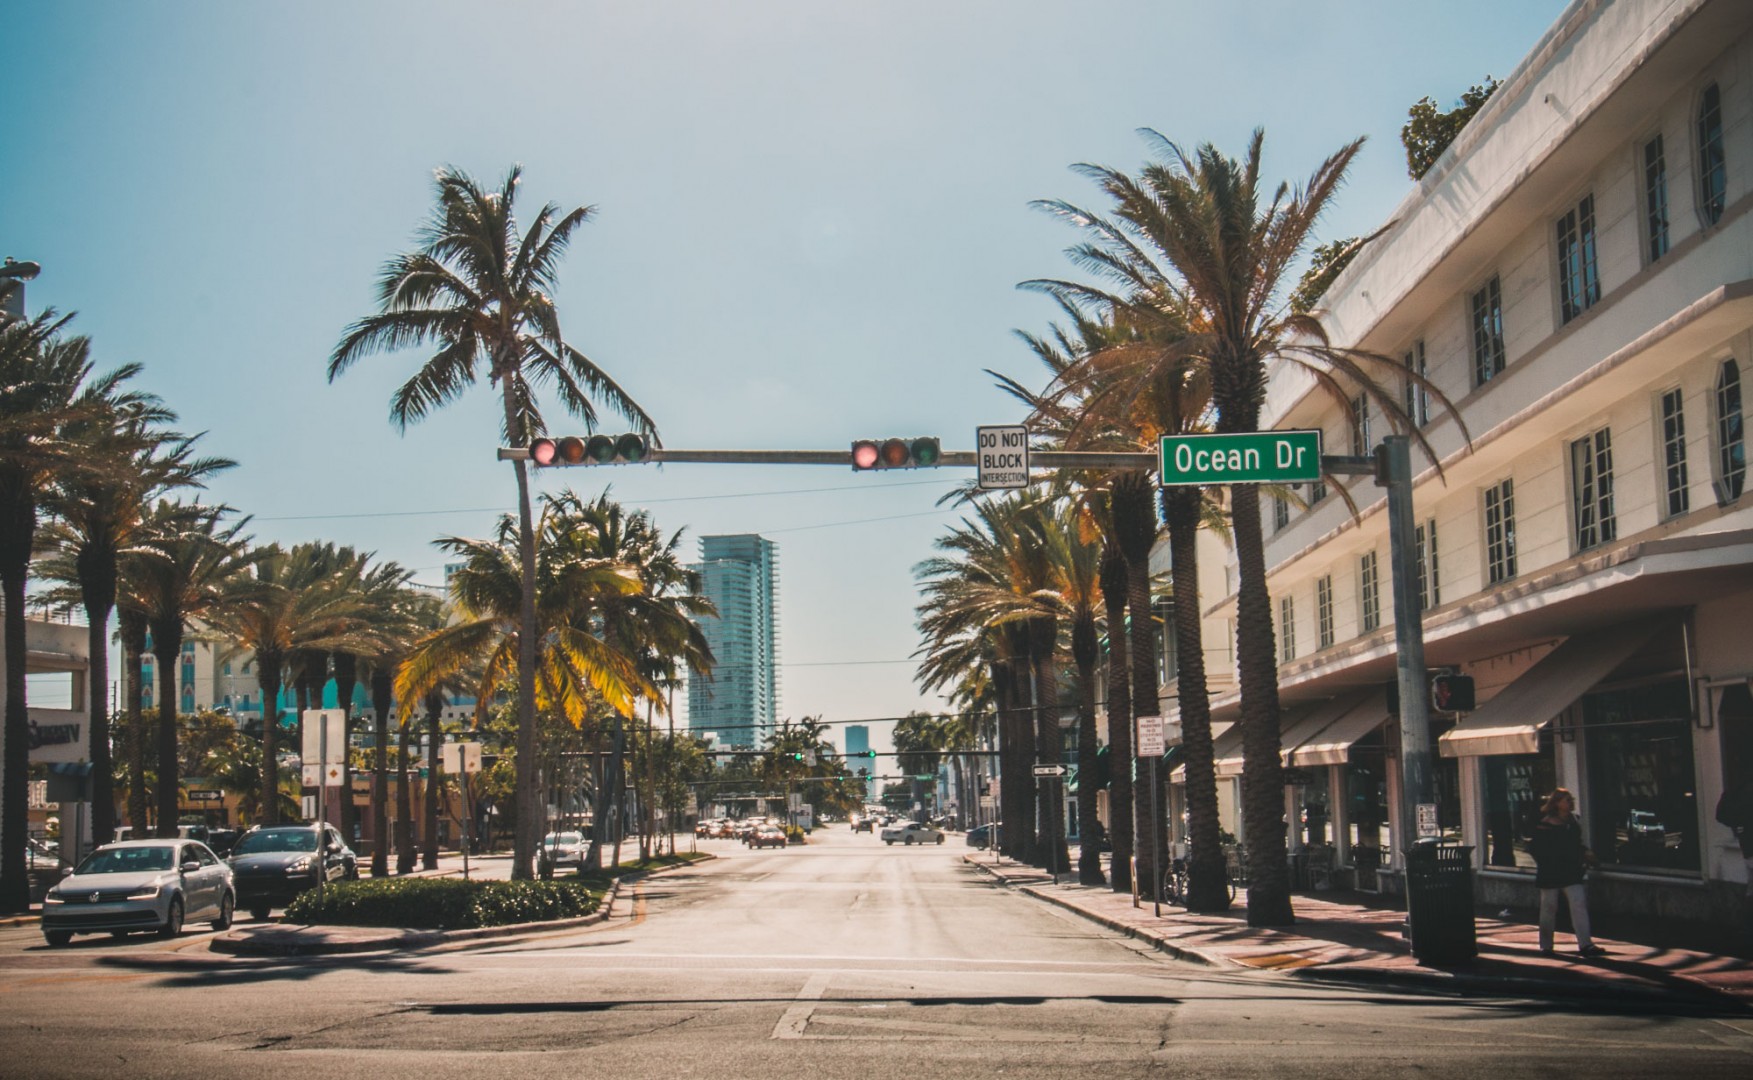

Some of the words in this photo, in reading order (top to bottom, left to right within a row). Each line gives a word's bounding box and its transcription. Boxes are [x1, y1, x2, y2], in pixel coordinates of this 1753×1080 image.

[980, 433, 997, 448] DO
[1001, 432, 1025, 447] NOT
[983, 453, 1023, 469] BLOCK
[1175, 443, 1260, 473] Ocean
[1276, 440, 1307, 469] Dr
[980, 472, 1027, 483] INTERSECTION
